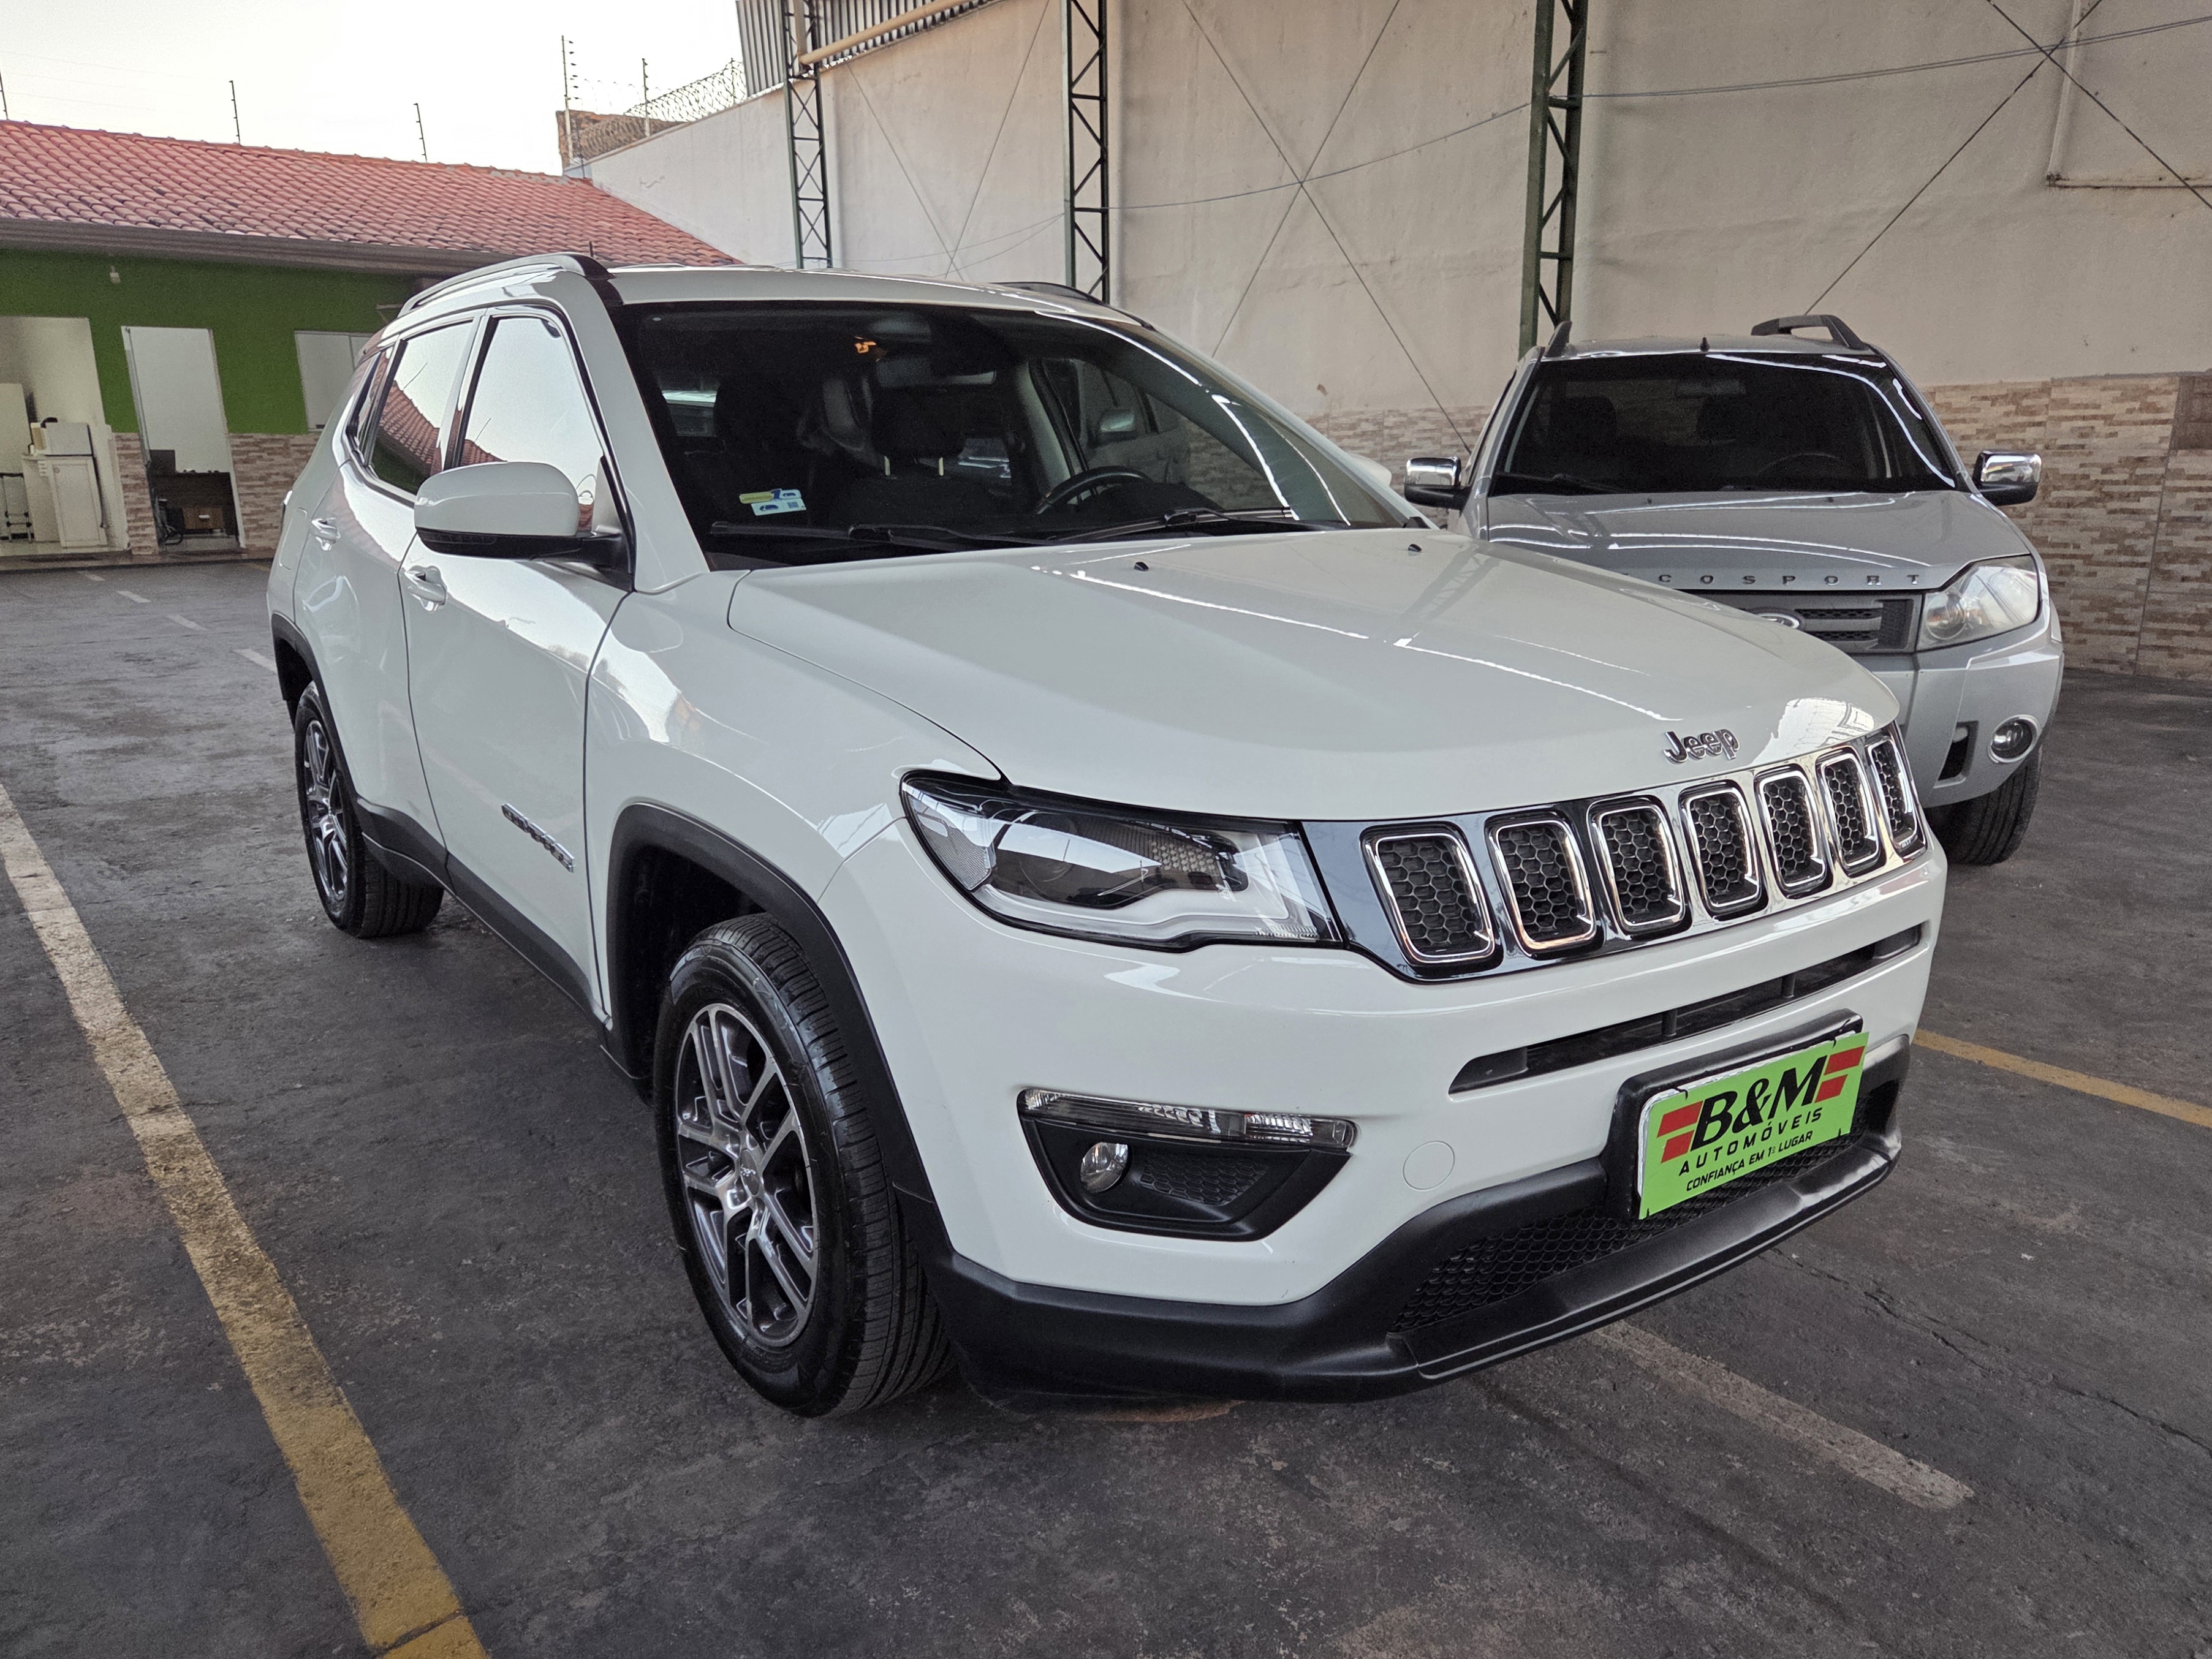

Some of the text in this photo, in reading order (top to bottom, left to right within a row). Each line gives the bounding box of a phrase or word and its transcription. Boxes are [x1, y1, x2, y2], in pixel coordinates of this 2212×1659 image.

[1623, 573, 1920, 586] COSPORT
[1663, 728, 1740, 763] Jeep
[1690, 1055, 1828, 1152] B&M
[1678, 1107, 1823, 1176] AUTOMÓVEIS
[1686, 1130, 1813, 1192] CONFIANÇA EM 1º LUGAR
